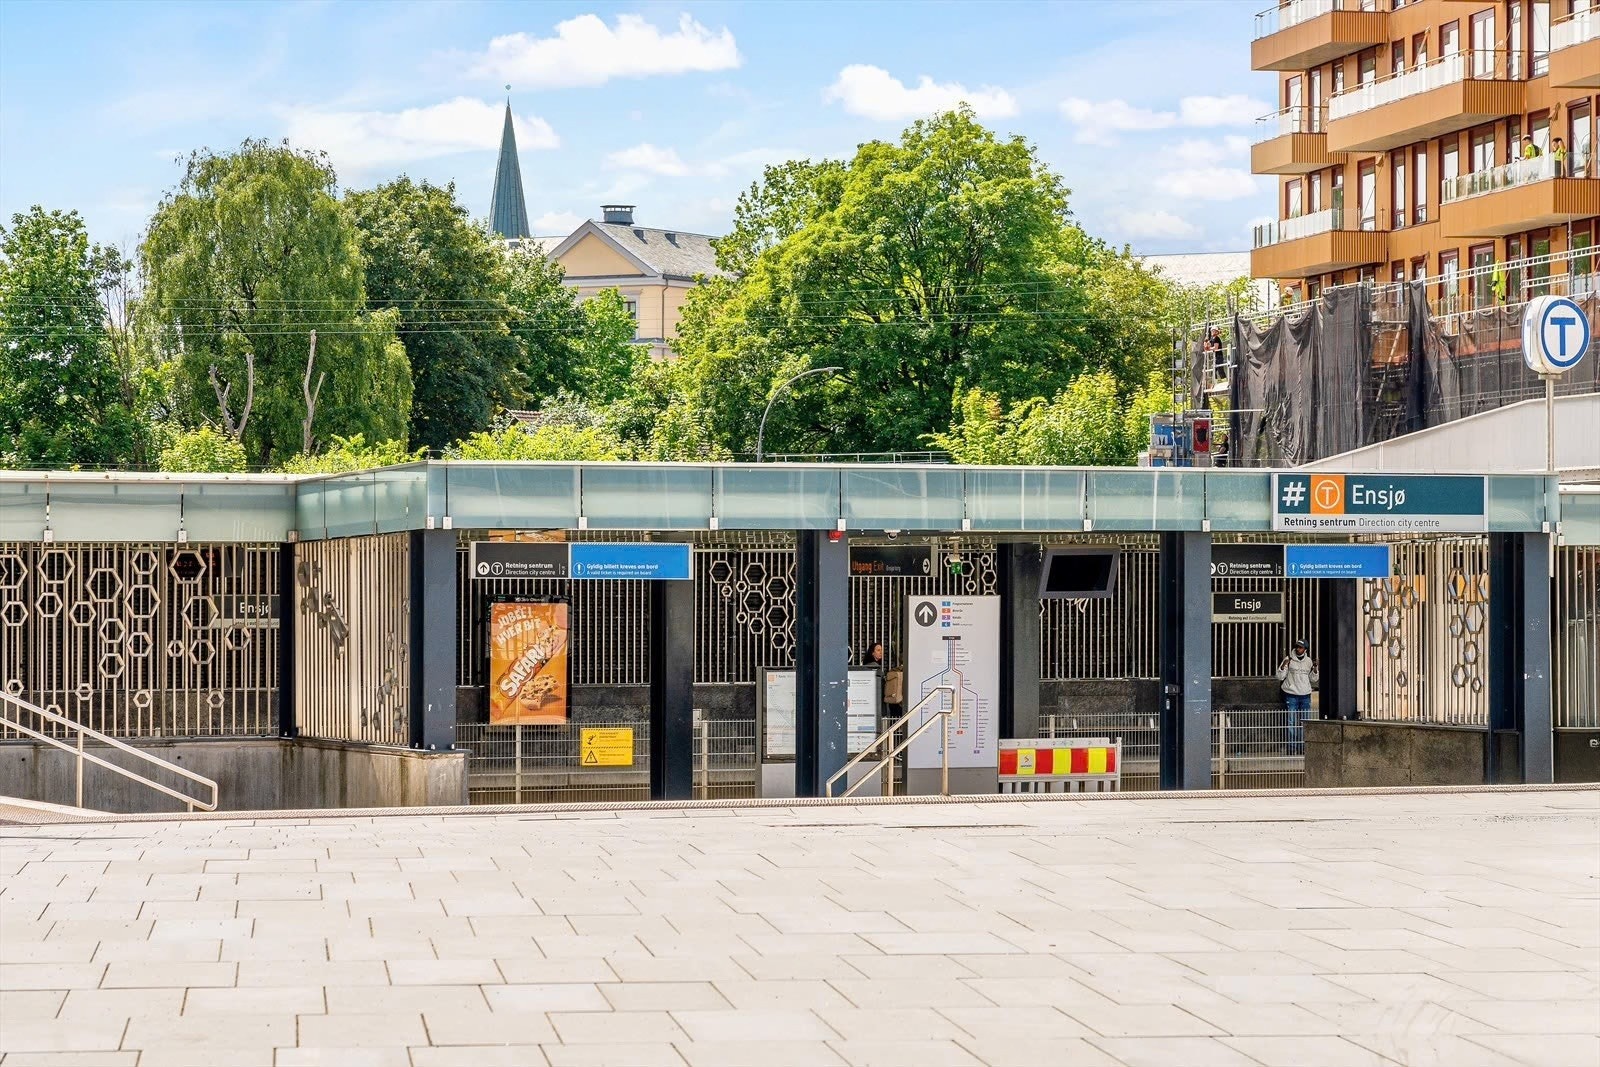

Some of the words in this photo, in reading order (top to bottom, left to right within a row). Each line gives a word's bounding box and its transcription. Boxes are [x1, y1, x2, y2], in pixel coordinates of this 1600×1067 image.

[1550, 317, 1576, 356] T
[1352, 484, 1406, 510] Ensjø
[1284, 517, 1317, 528] Retning
[1319, 518, 1356, 526] sentrum
[1358, 518, 1396, 526] Direction
[1398, 518, 1413, 528] city
[1414, 518, 1440, 527] centre
[852, 560, 872, 574] Utgang
[1234, 598, 1262, 612] Ensjø
[500, 644, 546, 698] SAFARI
